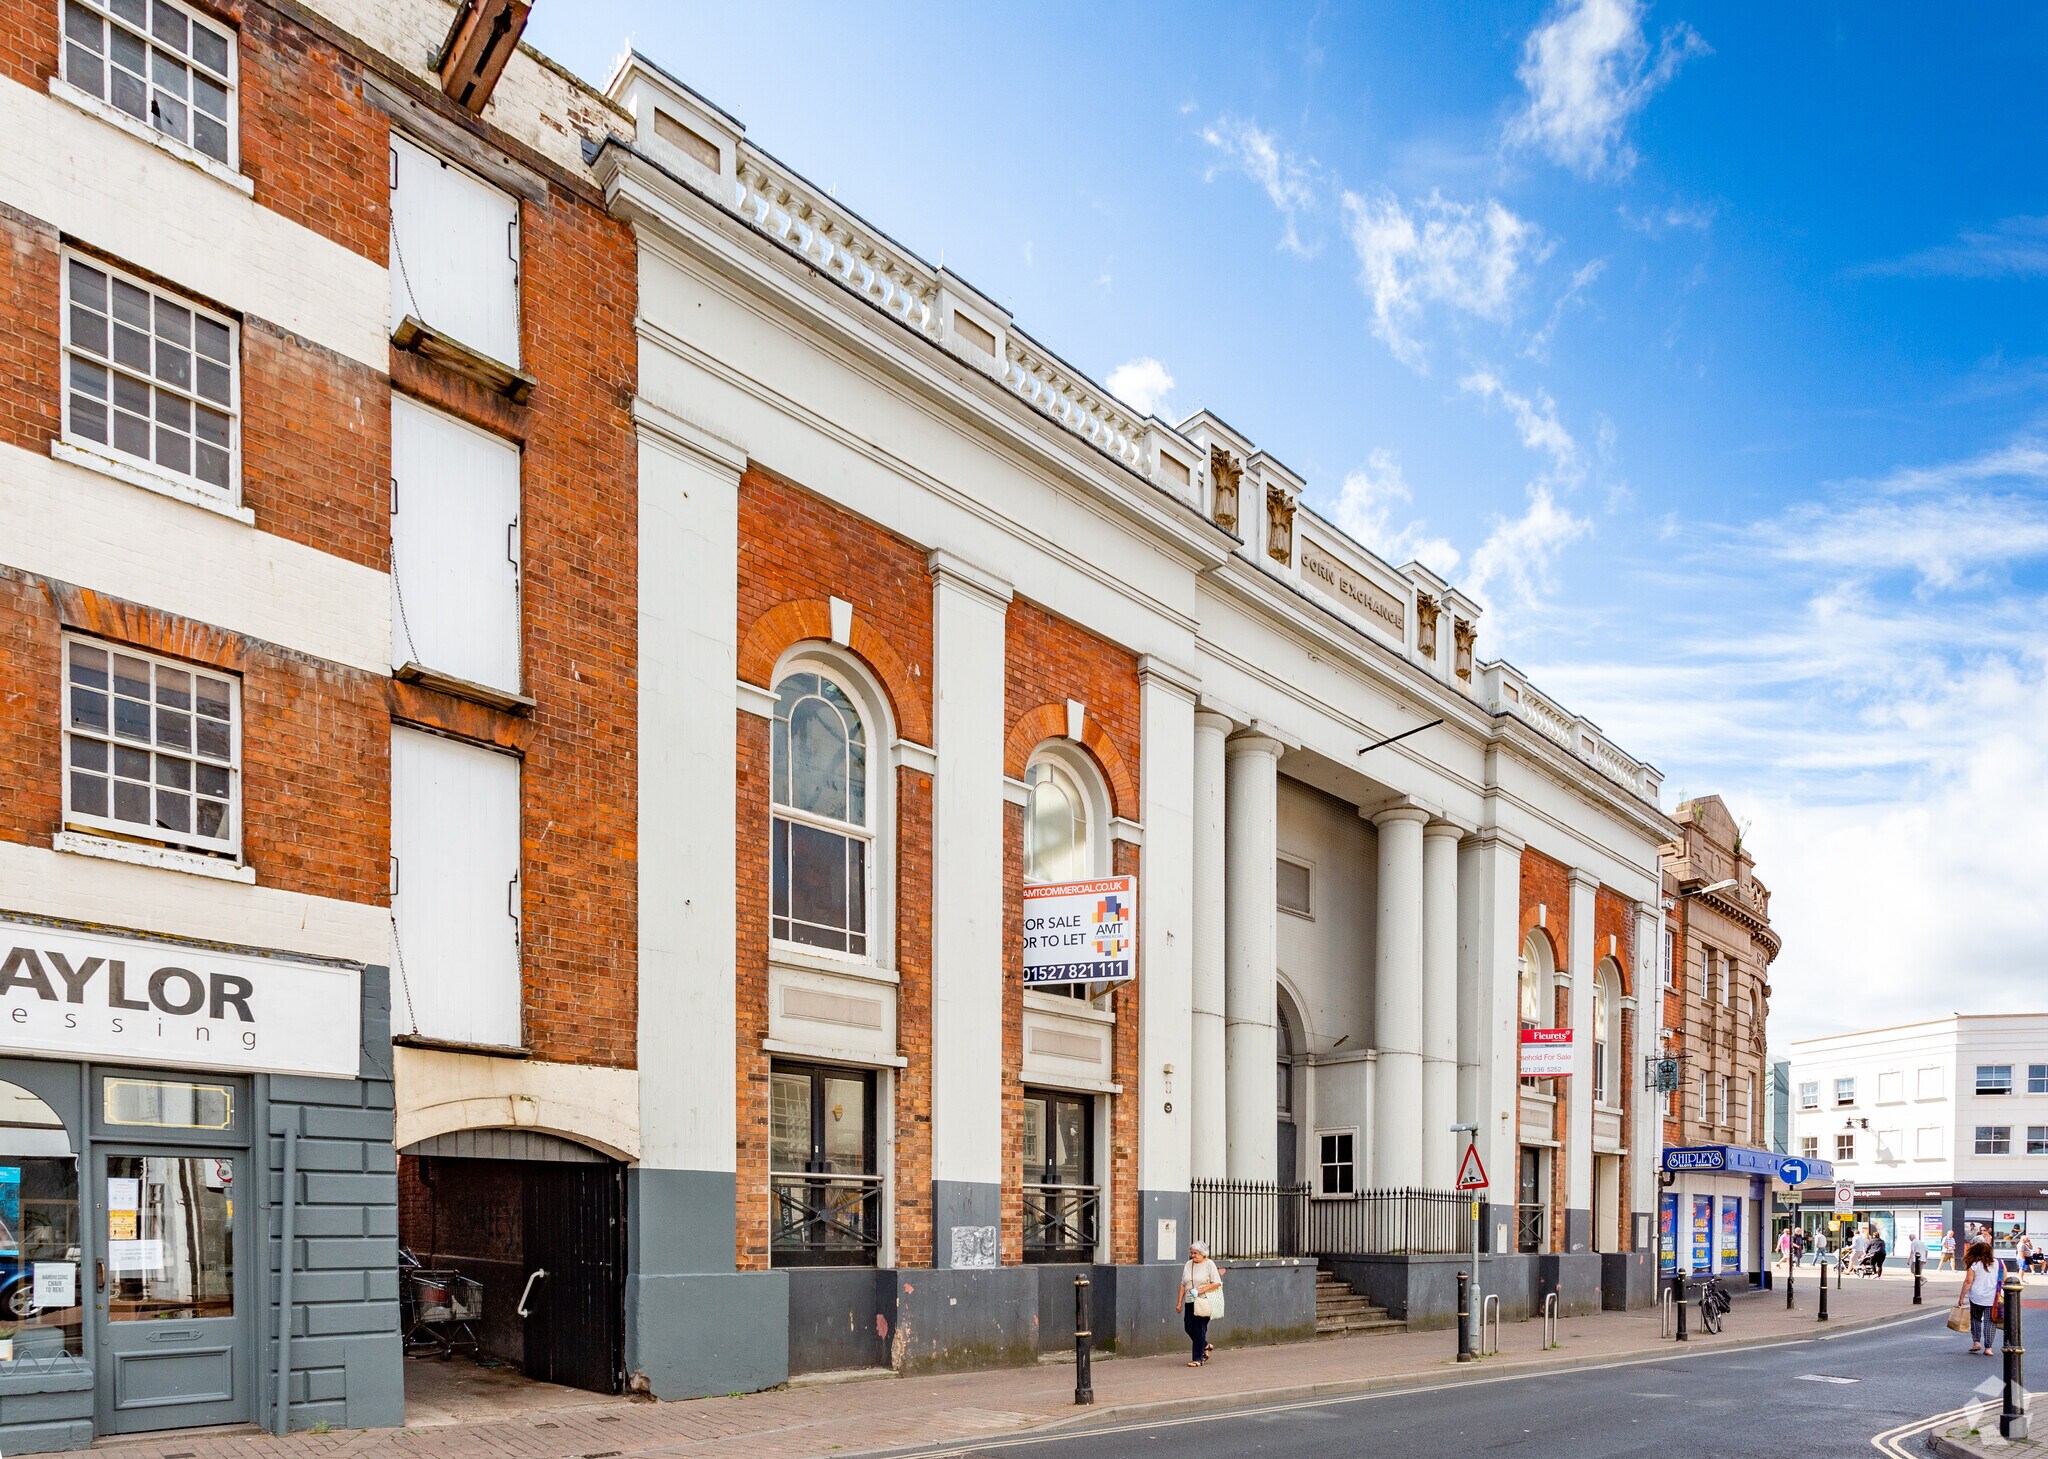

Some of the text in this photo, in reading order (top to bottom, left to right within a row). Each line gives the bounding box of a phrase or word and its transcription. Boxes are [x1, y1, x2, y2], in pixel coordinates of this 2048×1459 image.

[1300, 553, 1403, 631] CORN EXCHANGE
[1023, 915, 1081, 931] OR SALE
[1096, 923, 1123, 935] AMT
[1041, 935, 1060, 947] TO
[1063, 933, 1087, 946] LET
[1023, 961, 1123, 981] 01527 821 111
[1533, 1031, 1567, 1040] Fleurets
[1670, 1153, 1721, 1167] SHIPLEYS
